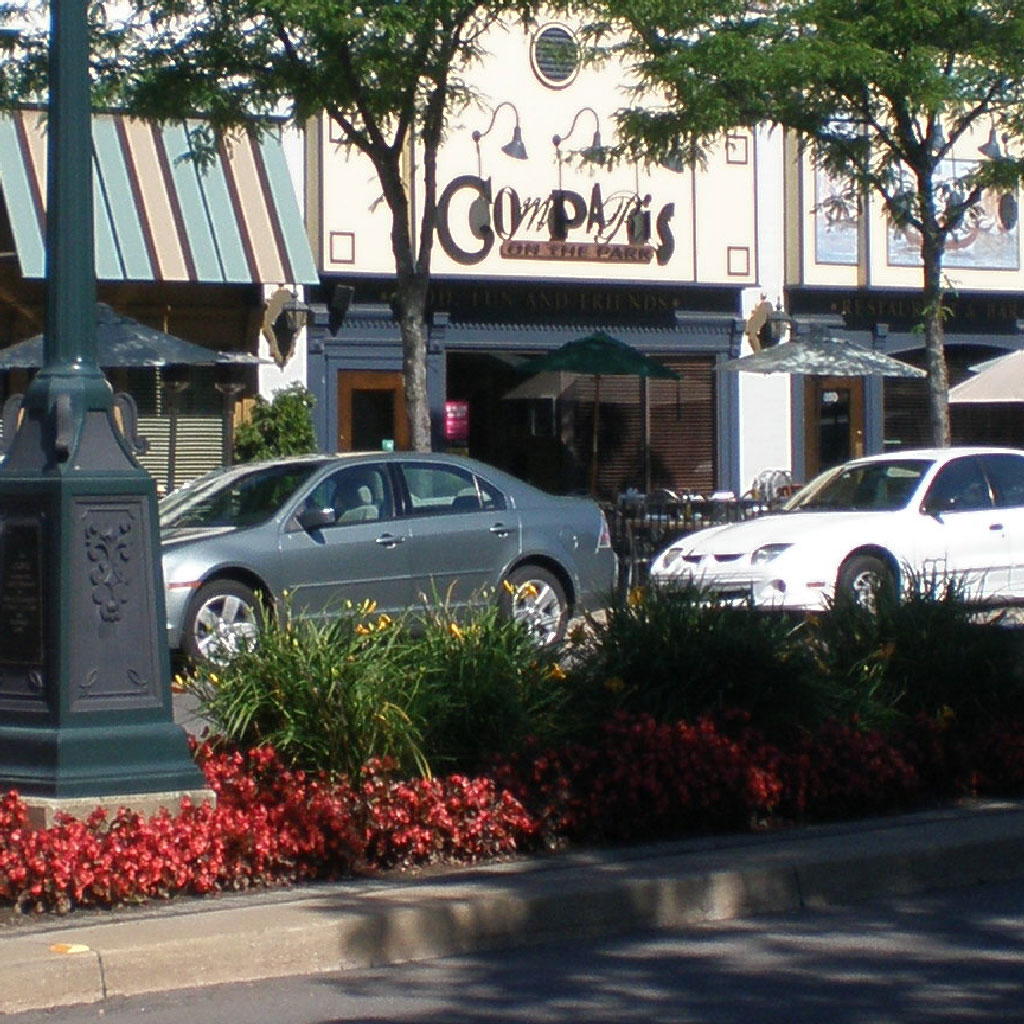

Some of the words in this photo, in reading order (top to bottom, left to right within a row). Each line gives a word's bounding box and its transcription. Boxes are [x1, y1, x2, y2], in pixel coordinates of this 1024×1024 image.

[507, 244, 540, 256] ON
[549, 245, 588, 257] THE
[597, 246, 653, 261] PARK
